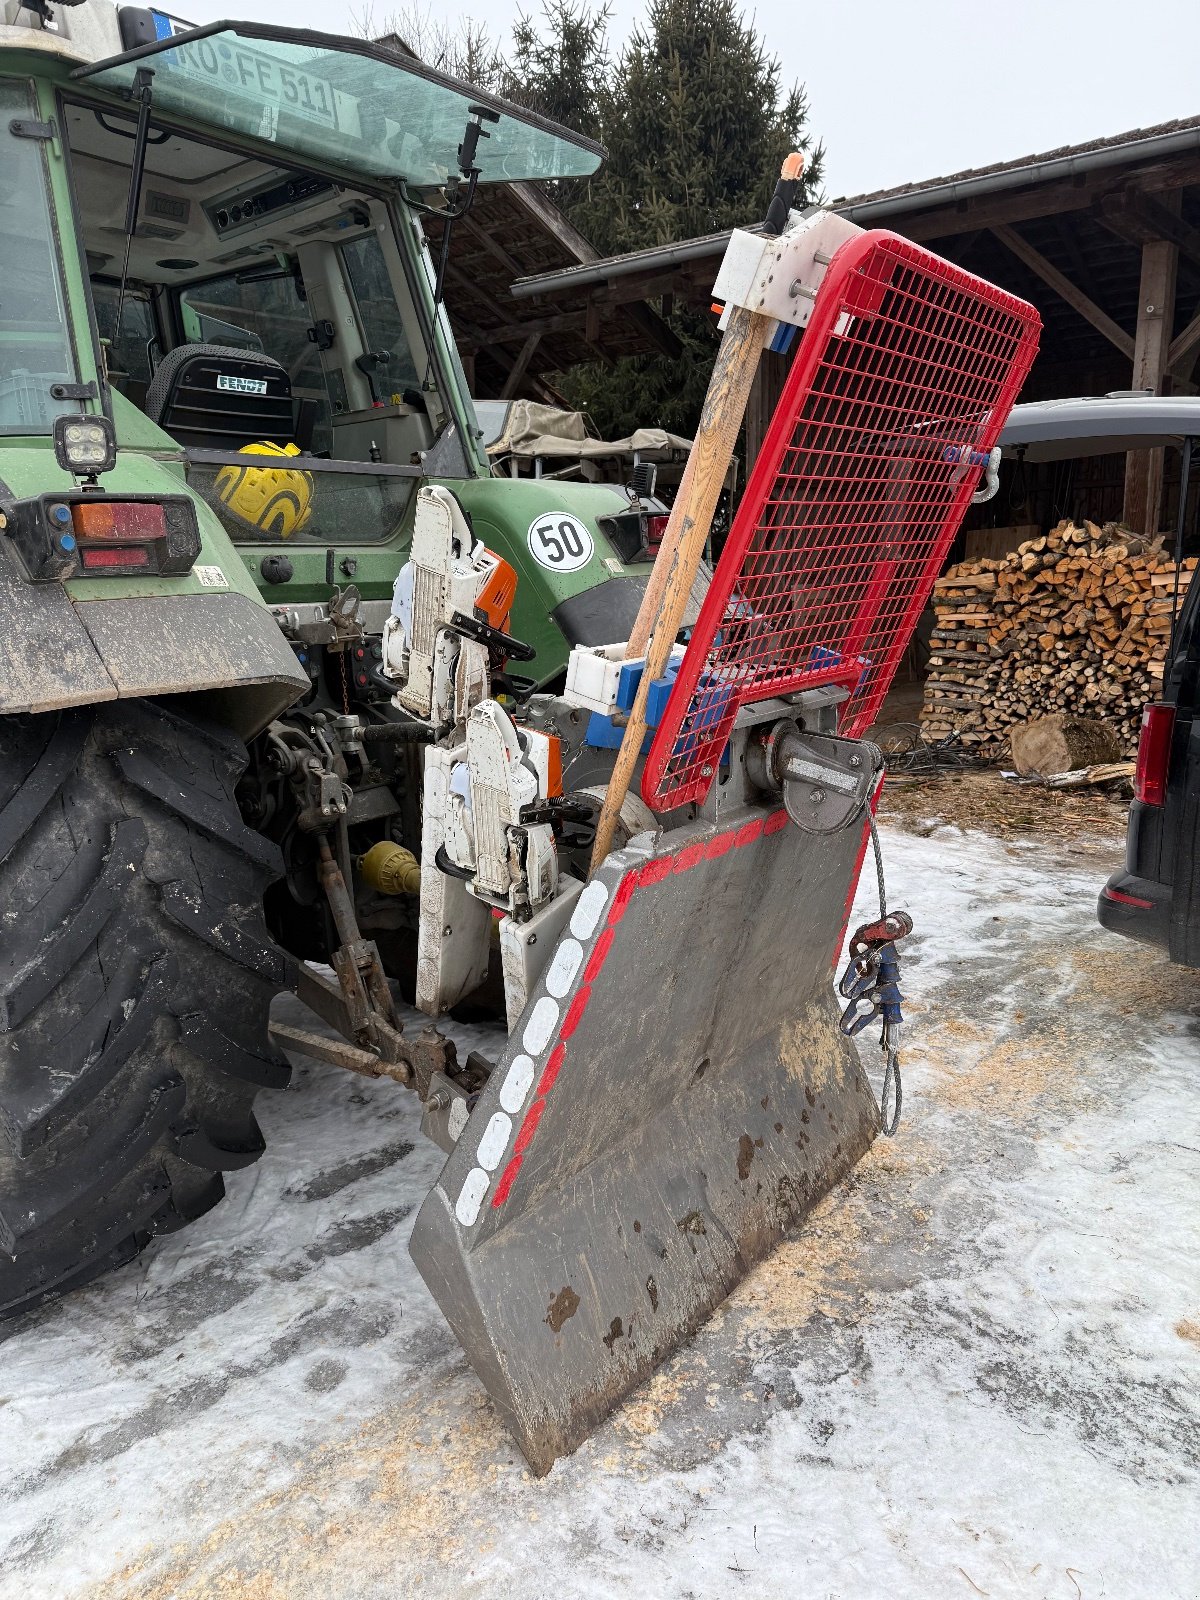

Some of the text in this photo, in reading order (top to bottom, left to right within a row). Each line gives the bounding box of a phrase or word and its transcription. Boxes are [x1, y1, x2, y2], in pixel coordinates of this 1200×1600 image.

[236, 51, 278, 97] FE
[279, 66, 332, 117] 511
[219, 376, 266, 392] FENDT
[537, 521, 584, 562] 50
